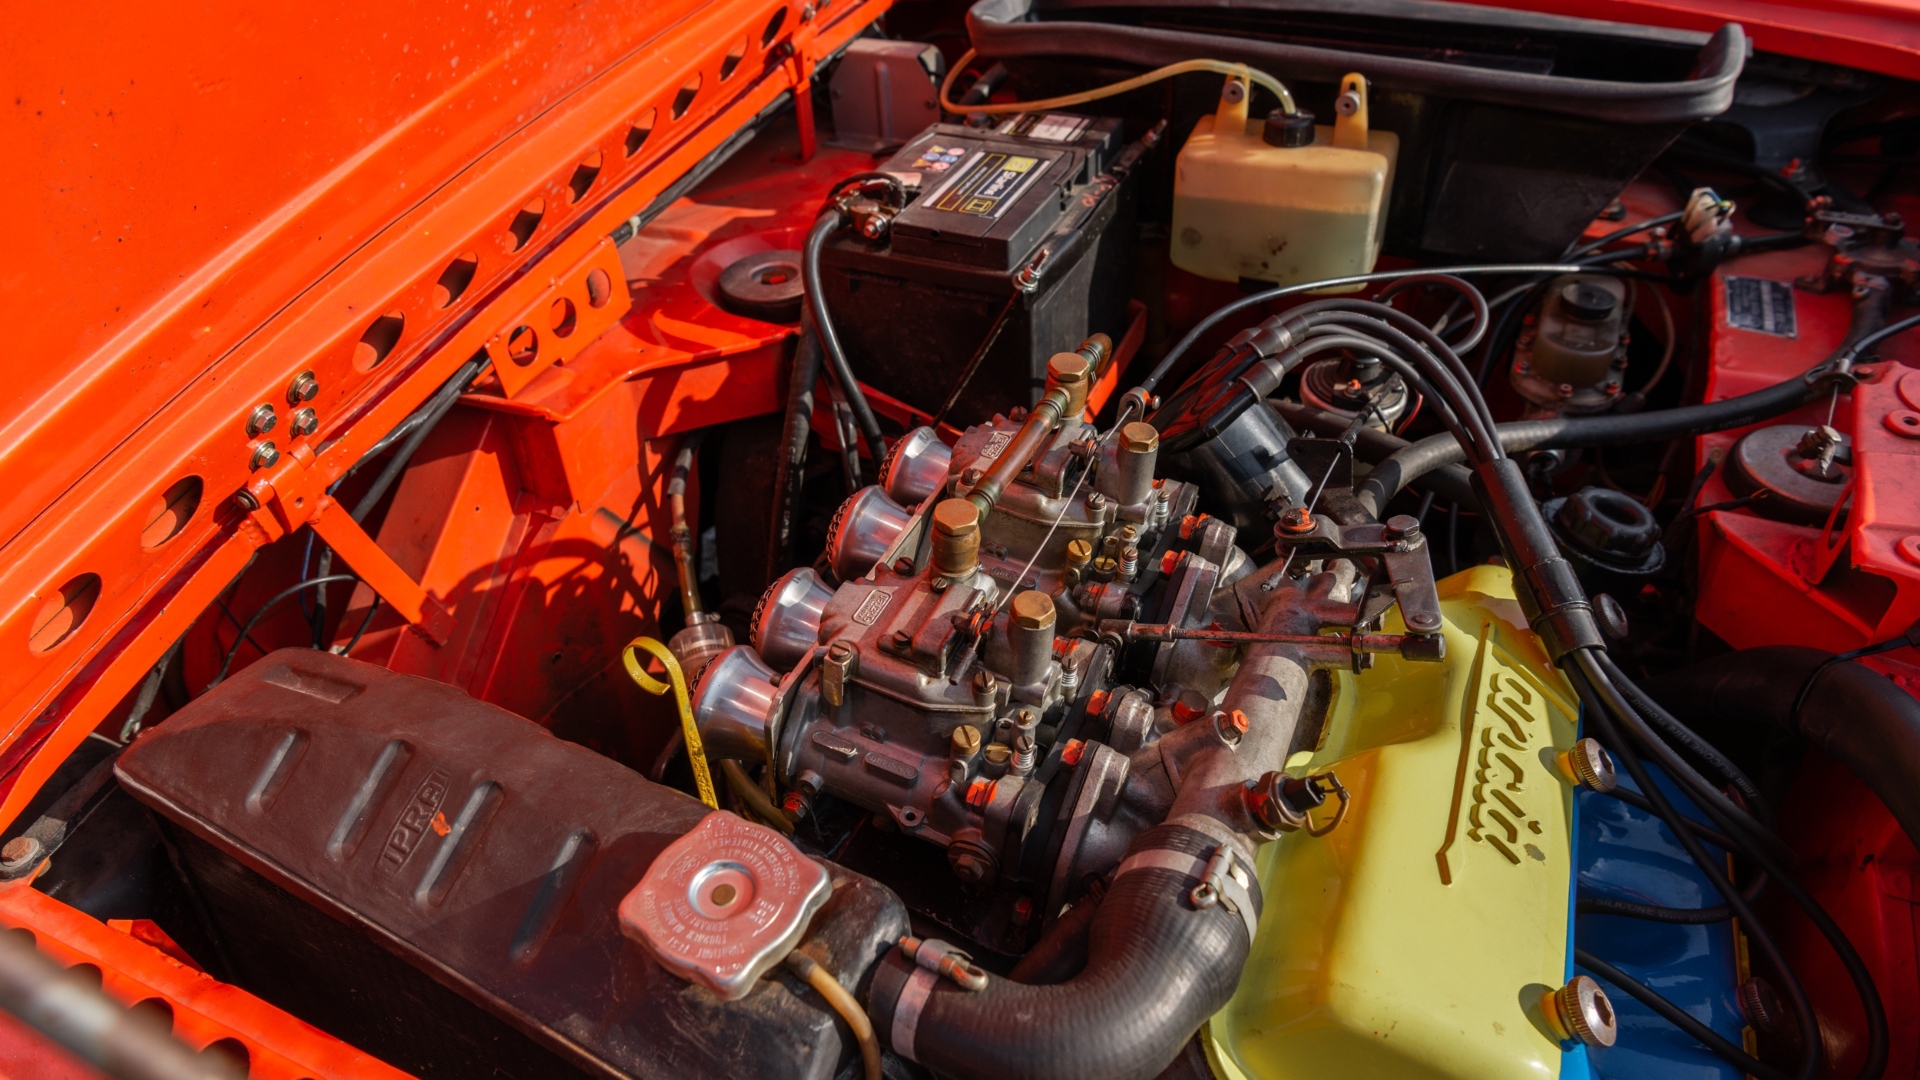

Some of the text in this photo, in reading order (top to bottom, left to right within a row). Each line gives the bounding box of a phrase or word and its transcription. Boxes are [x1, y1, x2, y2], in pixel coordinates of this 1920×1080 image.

[1630, 699, 1666, 728] Wound
[1667, 724, 1692, 746] Wire
[1691, 741, 1737, 779] SILICONE
[1597, 898, 1654, 916] SILICONE
